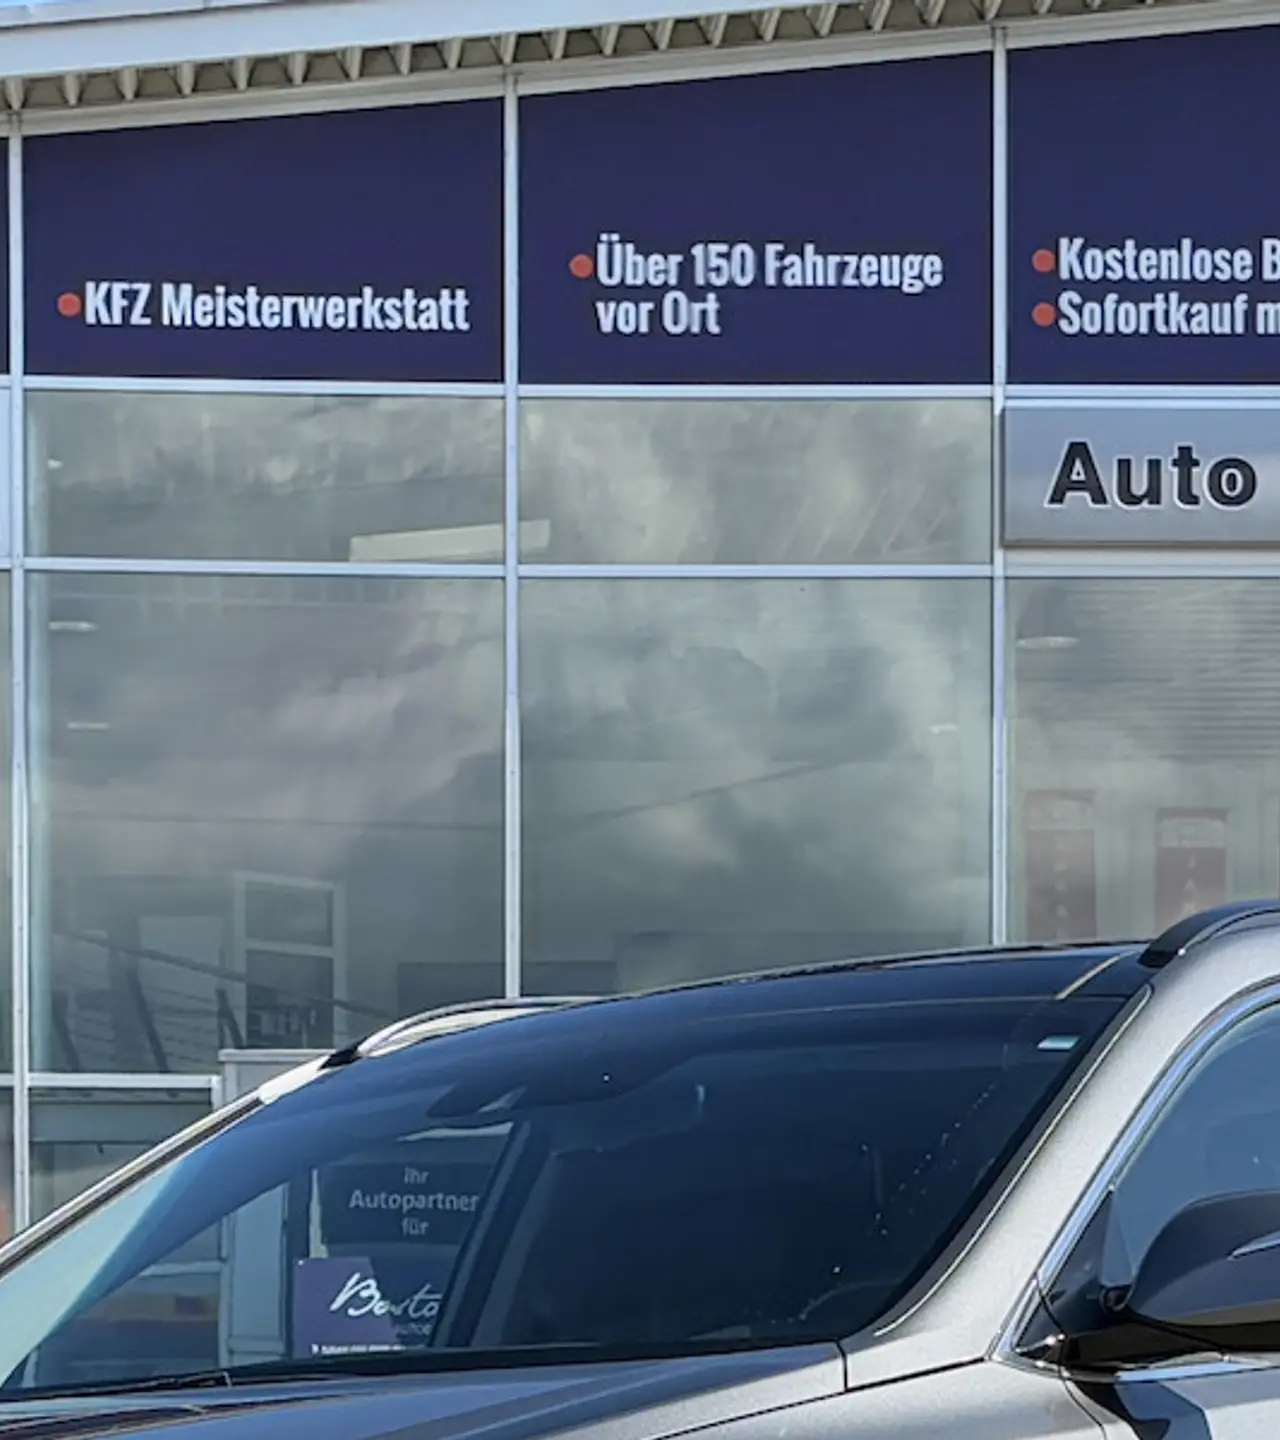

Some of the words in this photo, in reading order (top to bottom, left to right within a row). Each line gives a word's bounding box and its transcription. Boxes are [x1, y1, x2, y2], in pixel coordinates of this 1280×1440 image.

[596, 233, 684, 288] Über
[690, 243, 756, 288] 150
[764, 243, 944, 295] Fahrzeuge
[1058, 236, 1253, 281] Kostenlose
[84, 280, 152, 326] KFZ
[160, 282, 471, 332] Meisterwerkstatt
[595, 299, 656, 335] vor
[661, 289, 722, 336] Ort
[1058, 289, 1249, 336] Sofortkauf
[1046, 439, 1258, 510] Auto
[403, 1166, 429, 1184] Ihr
[348, 1189, 480, 1214] Autopartner
[402, 1217, 429, 1236] für
[329, 1271, 443, 1318] Bosta
